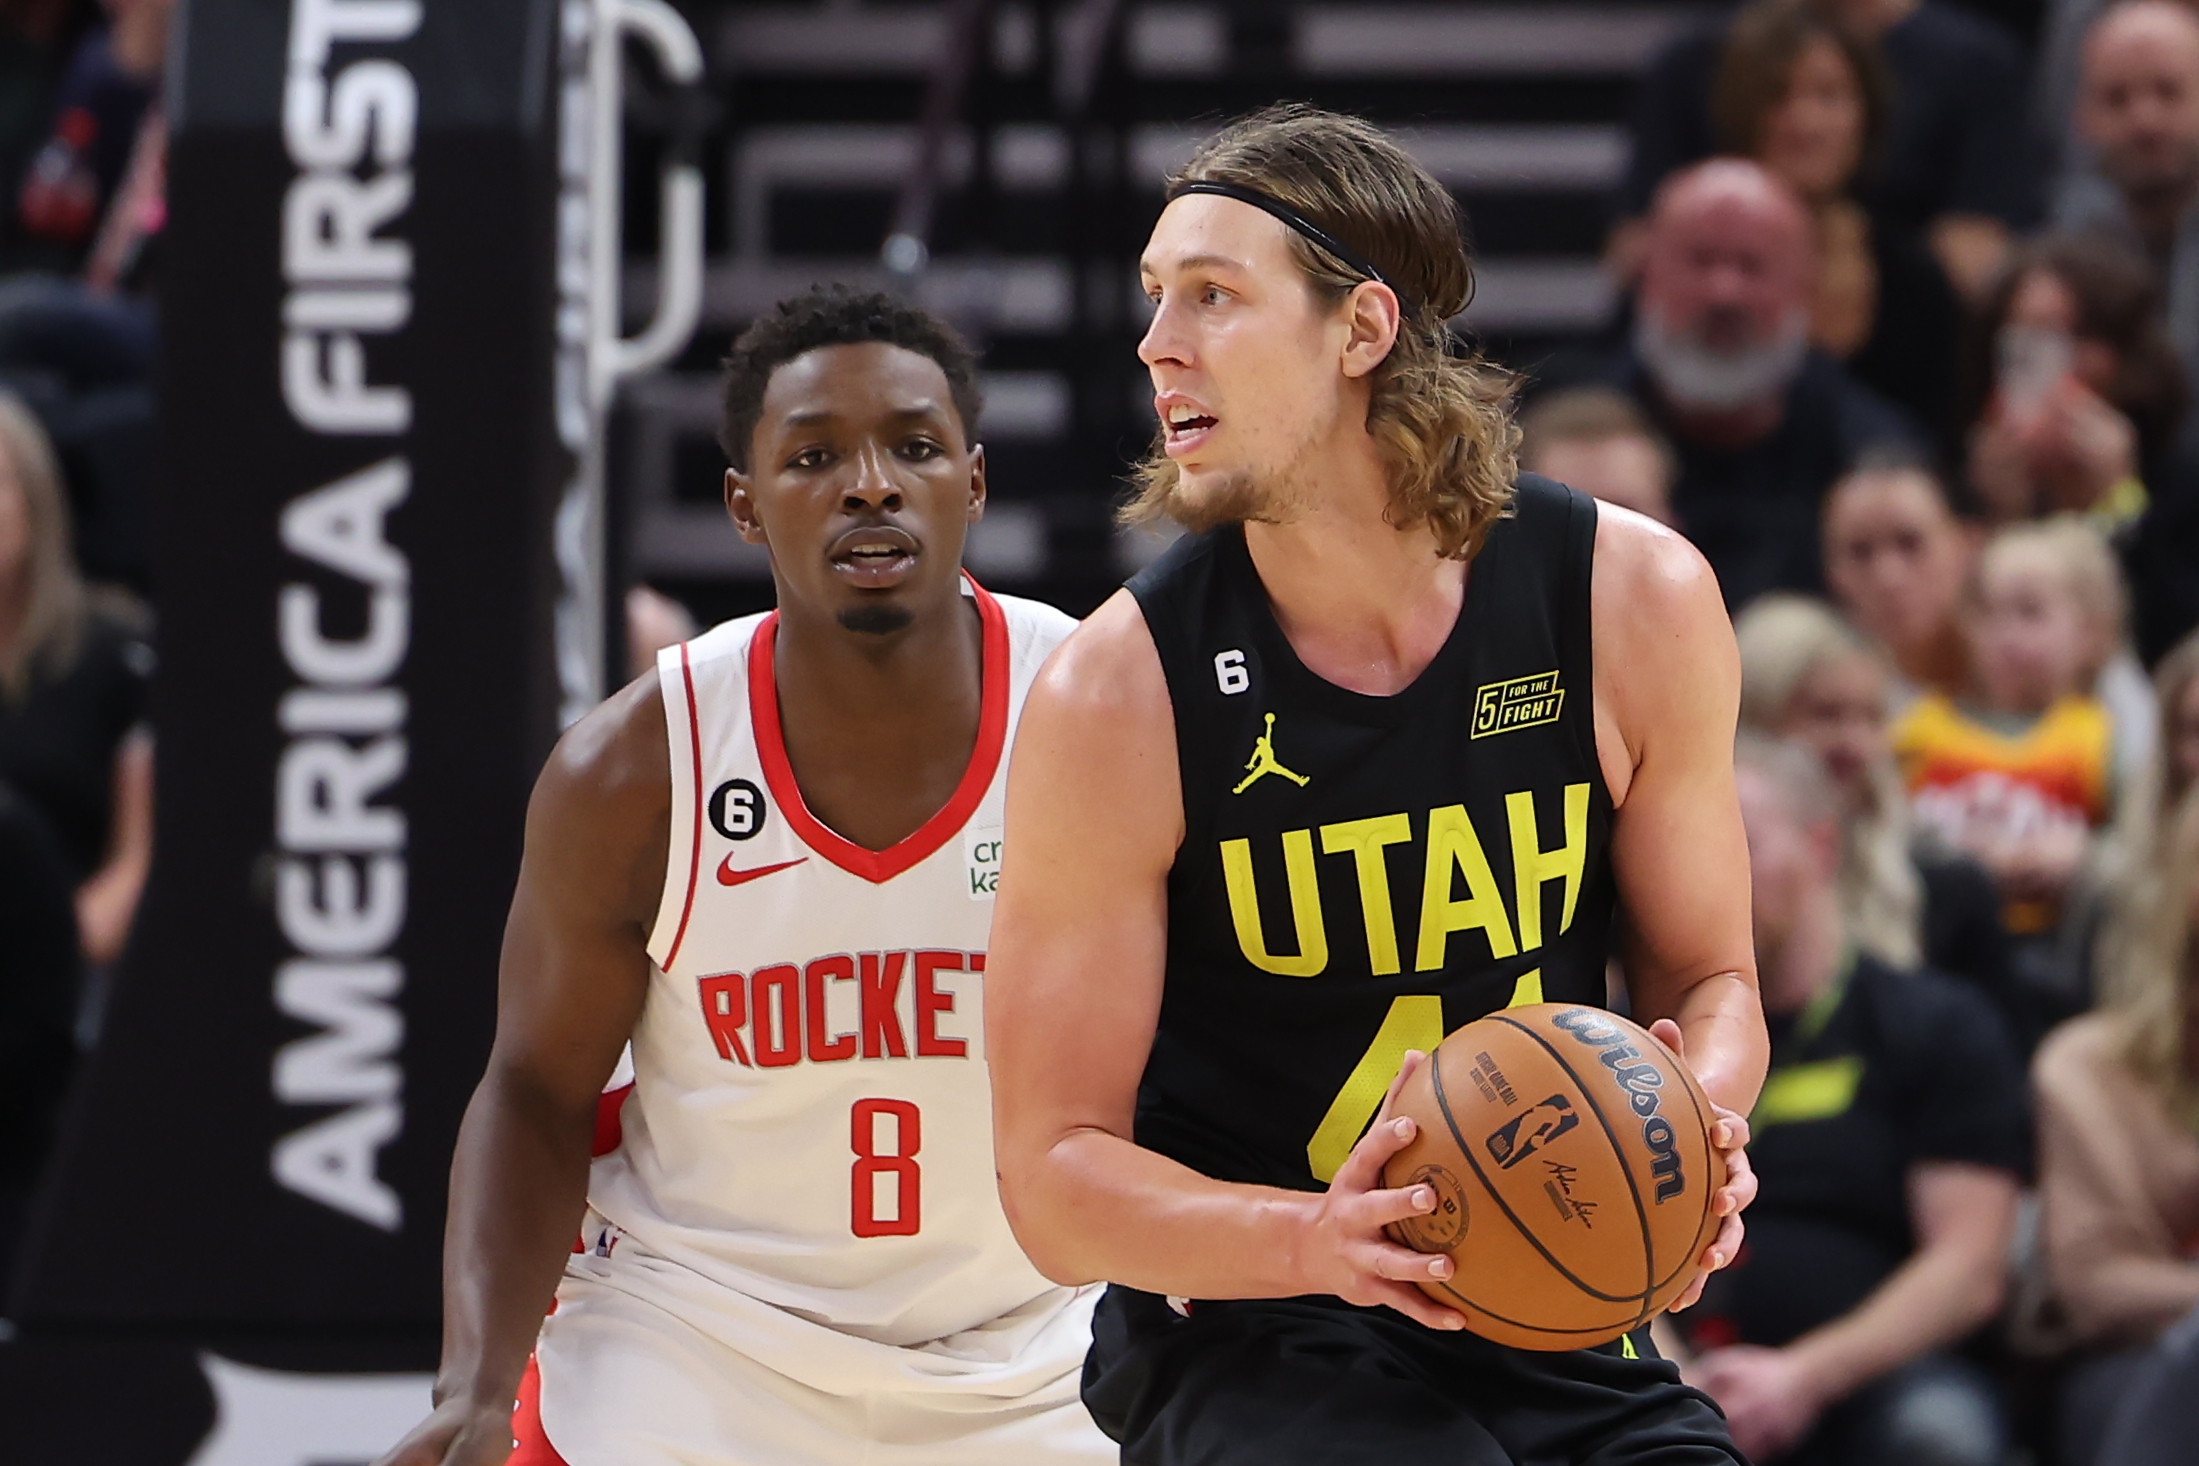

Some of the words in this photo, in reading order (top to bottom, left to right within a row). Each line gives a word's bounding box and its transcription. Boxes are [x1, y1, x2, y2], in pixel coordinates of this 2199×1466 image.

[282, 0, 424, 435] FIRST
[1213, 649, 1250, 695] 6
[1478, 691, 1499, 730] 5
[1503, 698, 1556, 725] FIGHT
[1508, 684, 1529, 698] FOR
[1530, 680, 1549, 693] THE
[270, 454, 412, 1233] AMERICA
[722, 788, 755, 834] 6
[1219, 782, 1591, 978] UTAH
[696, 948, 987, 1070] ROCKE
[850, 1097, 921, 1238] 8
